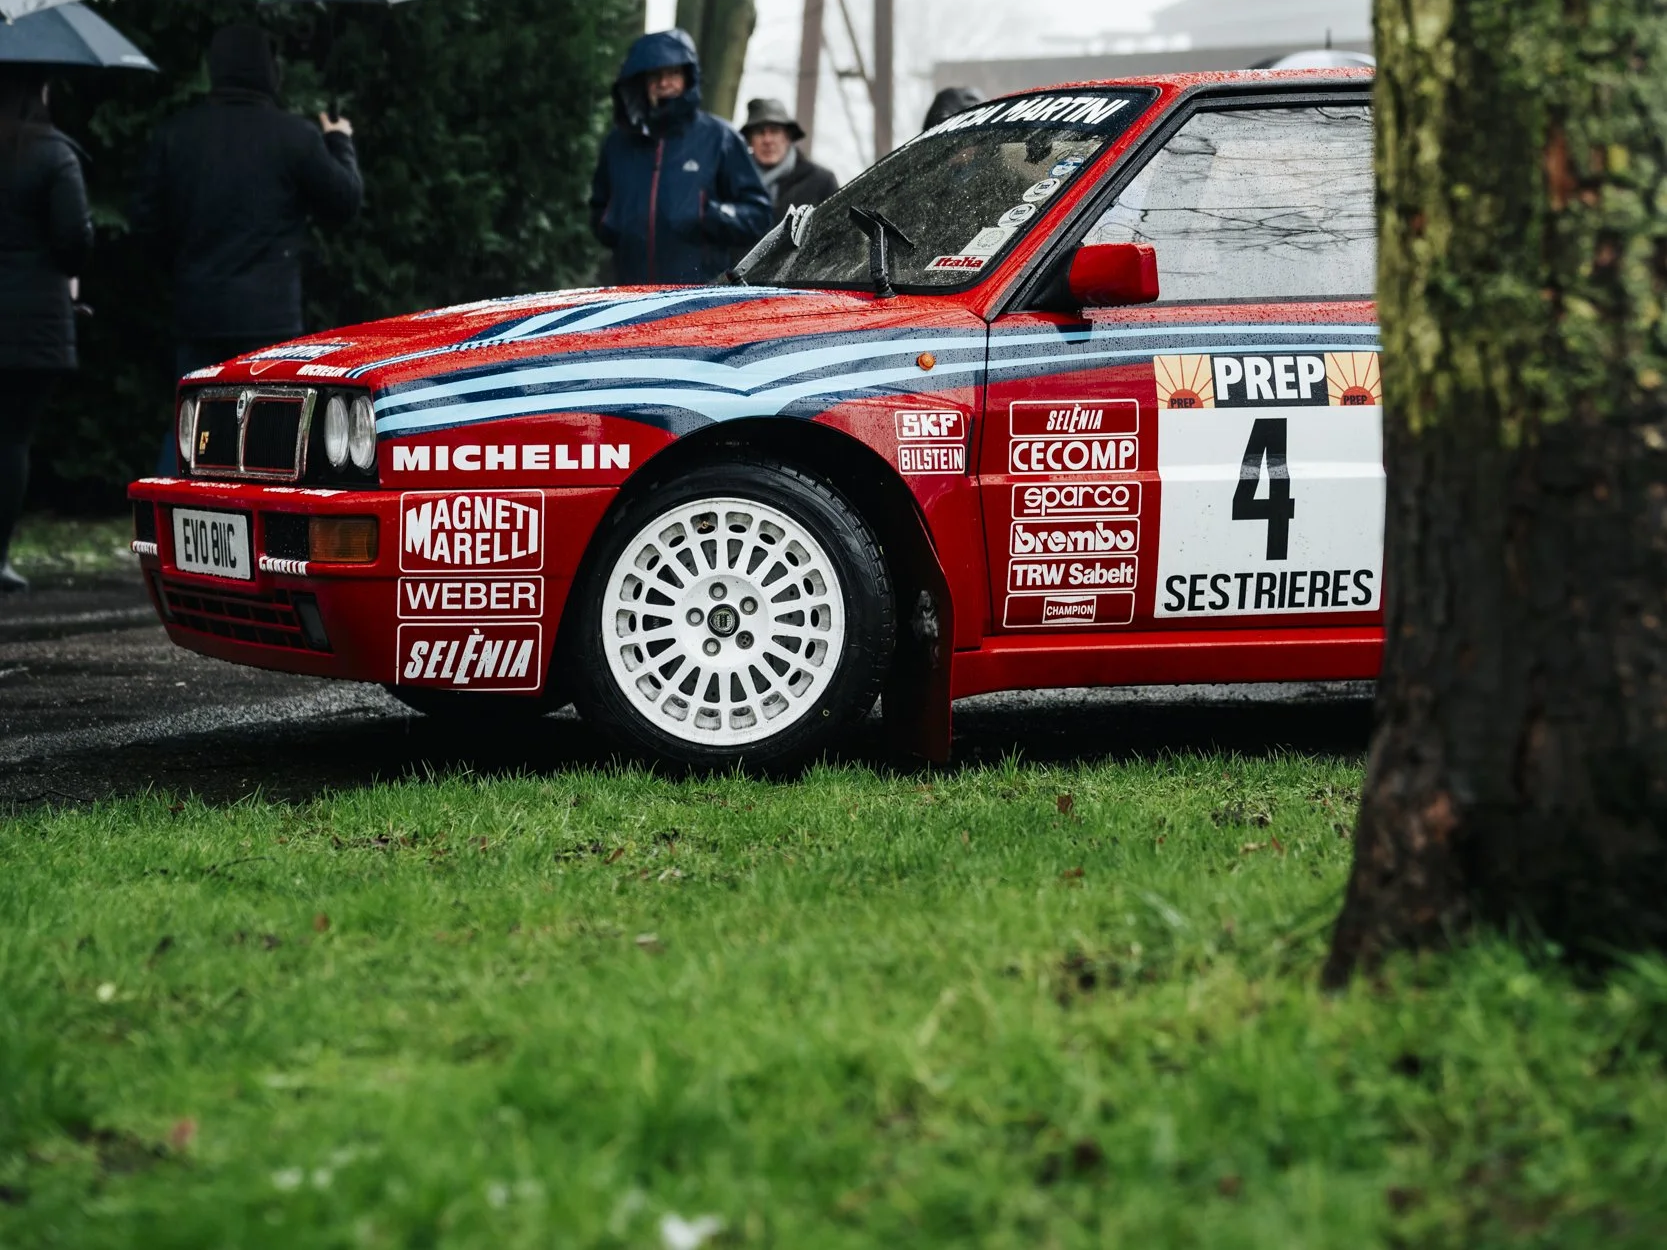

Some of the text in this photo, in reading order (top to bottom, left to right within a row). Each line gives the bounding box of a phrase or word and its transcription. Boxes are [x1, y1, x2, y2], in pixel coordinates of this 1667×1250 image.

[990, 96, 1130, 125] MARTINI
[933, 256, 984, 269] Italia
[1213, 356, 1326, 400] PREP
[1170, 398, 1196, 409] PREP
[1343, 395, 1367, 406] PREP
[902, 414, 958, 437] SKF
[1046, 404, 1103, 433] SELÈNIA
[393, 444, 631, 471] MICHELIN
[901, 448, 963, 470] BILSTEIN
[1013, 441, 1136, 471] CECOMP
[1024, 486, 1130, 516] sparco
[1232, 418, 1295, 560] 4
[405, 495, 539, 531] MAGNETI
[182, 517, 209, 565] EVO
[405, 531, 539, 566] MARELLI
[1014, 522, 1135, 553] brembo
[1012, 562, 1134, 586] TRW Sabelt
[405, 582, 536, 609] WEBER
[1164, 569, 1374, 612] SESTRIERES
[1046, 605, 1095, 616] CHAMPION
[403, 628, 534, 684] SELÈNIA
